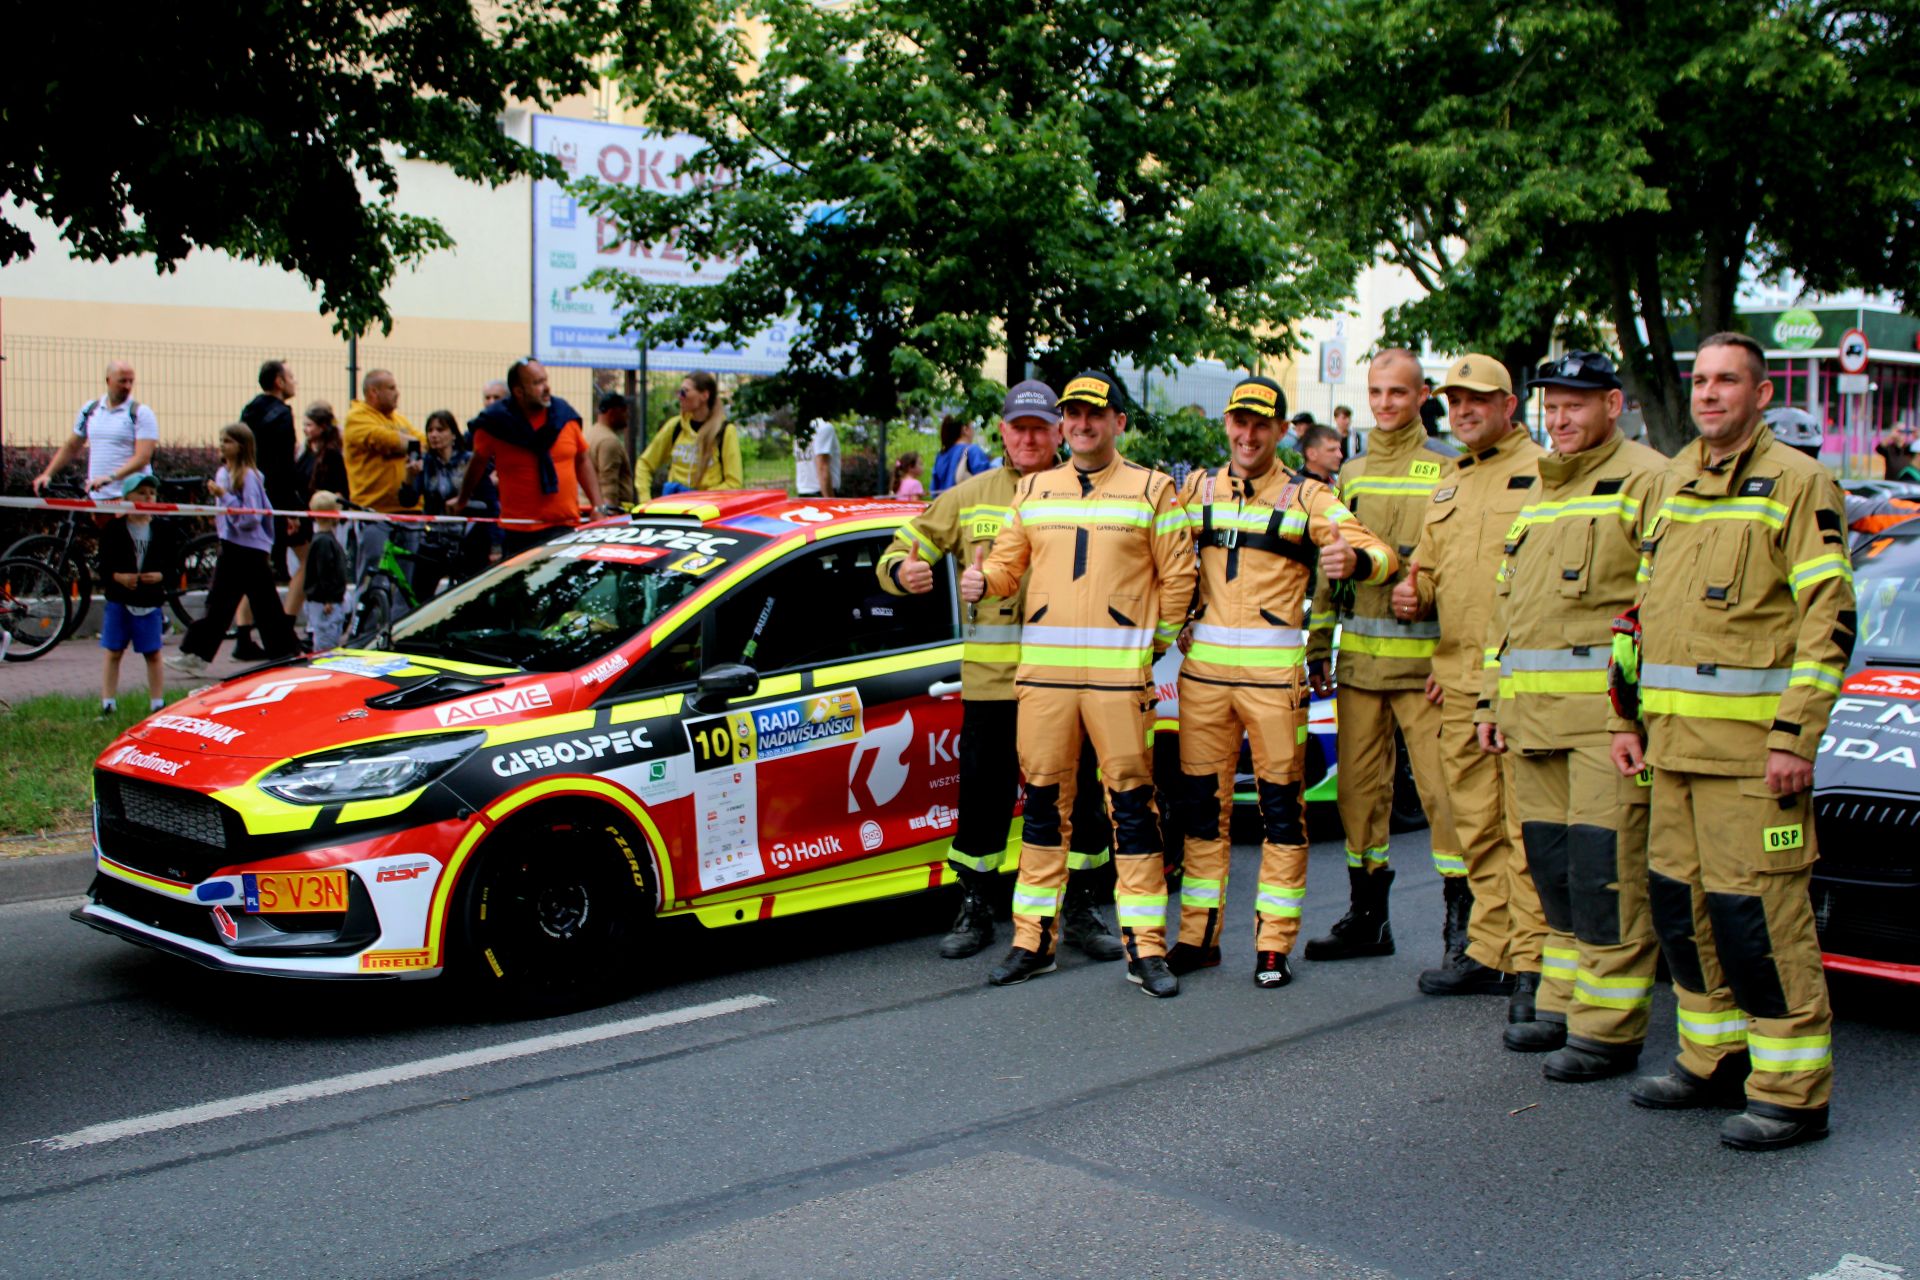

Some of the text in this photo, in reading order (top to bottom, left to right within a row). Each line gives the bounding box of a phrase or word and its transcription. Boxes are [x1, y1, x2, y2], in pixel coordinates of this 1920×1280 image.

[1774, 319, 1823, 344] Gucio
[1331, 356, 1341, 371] 30
[1414, 464, 1438, 476] OSP
[976, 522, 998, 533] OSP
[580, 654, 623, 685] RALLYLAB
[1847, 683, 1920, 696] ORLEN
[447, 688, 550, 724] ACME
[758, 709, 800, 733] RAJD
[758, 715, 854, 751] NADWIŚLAŃSKI
[491, 726, 654, 778] CARBOSPEC
[695, 727, 730, 760] 10
[1770, 829, 1799, 847] OSP
[246, 896, 259, 907] PL
[259, 874, 344, 908] S V3N
[362, 950, 431, 969] PIRELLI
